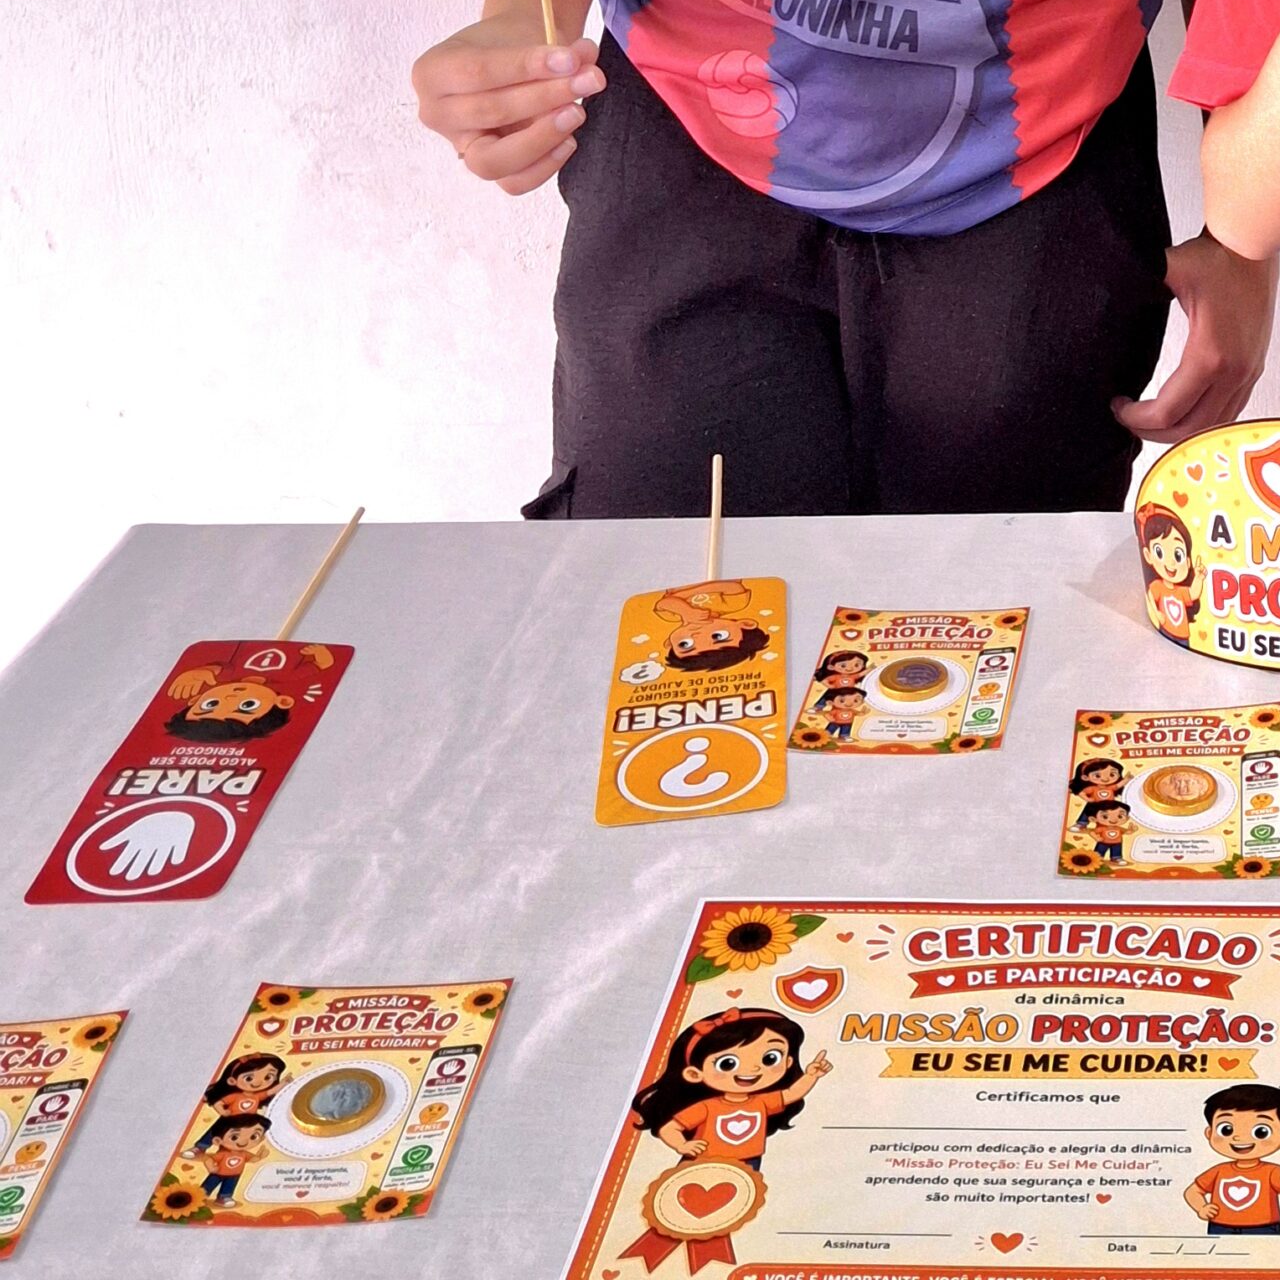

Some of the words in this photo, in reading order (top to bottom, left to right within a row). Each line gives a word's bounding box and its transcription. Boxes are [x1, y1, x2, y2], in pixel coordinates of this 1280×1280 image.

[1211, 515, 1232, 543] A
[1218, 629, 1245, 652] EU
[709, 672, 762, 683] PRECISO
[634, 681, 682, 693] AJUDA?
[692, 688, 699, 696] É
[703, 686, 729, 694] QUE
[734, 681, 766, 692] SERÁ
[628, 690, 687, 703] SEGURO?
[614, 691, 776, 733] PENSE!
[1154, 717, 1203, 726] MISSÃO
[1115, 725, 1251, 744] PROTEÇÃO
[172, 747, 245, 756] PERIGOSO!
[150, 757, 176, 765] SER
[180, 757, 216, 765] PODE
[220, 757, 257, 765] ALGO
[108, 769, 262, 795] PARE!
[909, 924, 1260, 966] CERTIFICADO
[967, 971, 996, 986] DE
[1007, 969, 1182, 988] PARTICIPAÇÃO
[348, 996, 409, 1008] MISSÃO
[1015, 994, 1036, 1005] da
[1043, 993, 1125, 1005] dinâmica
[291, 1008, 458, 1034] PROTEÇÃO
[840, 1007, 1020, 1043] MISSÃO
[1031, 1008, 1275, 1049] PROTEÇÃO:
[912, 1053, 953, 1072] EU
[963, 1053, 1012, 1072] SEI
[1022, 1054, 1069, 1072] ME
[1080, 1054, 1208, 1074] CUIDAR!
[976, 1091, 1084, 1104] Certificamos
[1089, 1093, 1121, 1105] que
[869, 1143, 939, 1156] participou
[944, 1145, 972, 1153] com
[977, 1144, 1045, 1155] dedicação
[1060, 1144, 1102, 1155] alegria
[1110, 1144, 1127, 1153] da
[1131, 1144, 1192, 1154] dinâmica
[948, 1159, 1020, 1171] Proteção:
[1025, 1160, 1043, 1169] Eu
[1048, 1160, 1070, 1169] Sei
[1075, 1160, 1097, 1170] Me
[865, 1176, 948, 1186] aprendendo
[953, 1177, 979, 1187] que
[983, 1178, 1007, 1186] sua
[1011, 1177, 1083, 1187] segurança
[1087, 1178, 1095, 1186] e
[1100, 1177, 1172, 1186] bem-estar
[925, 1193, 949, 1202] são
[954, 1193, 995, 1202] muito
[999, 1193, 1090, 1204] importantes!
[822, 1238, 891, 1250] Assinatura
[1108, 1243, 1137, 1252] Data
